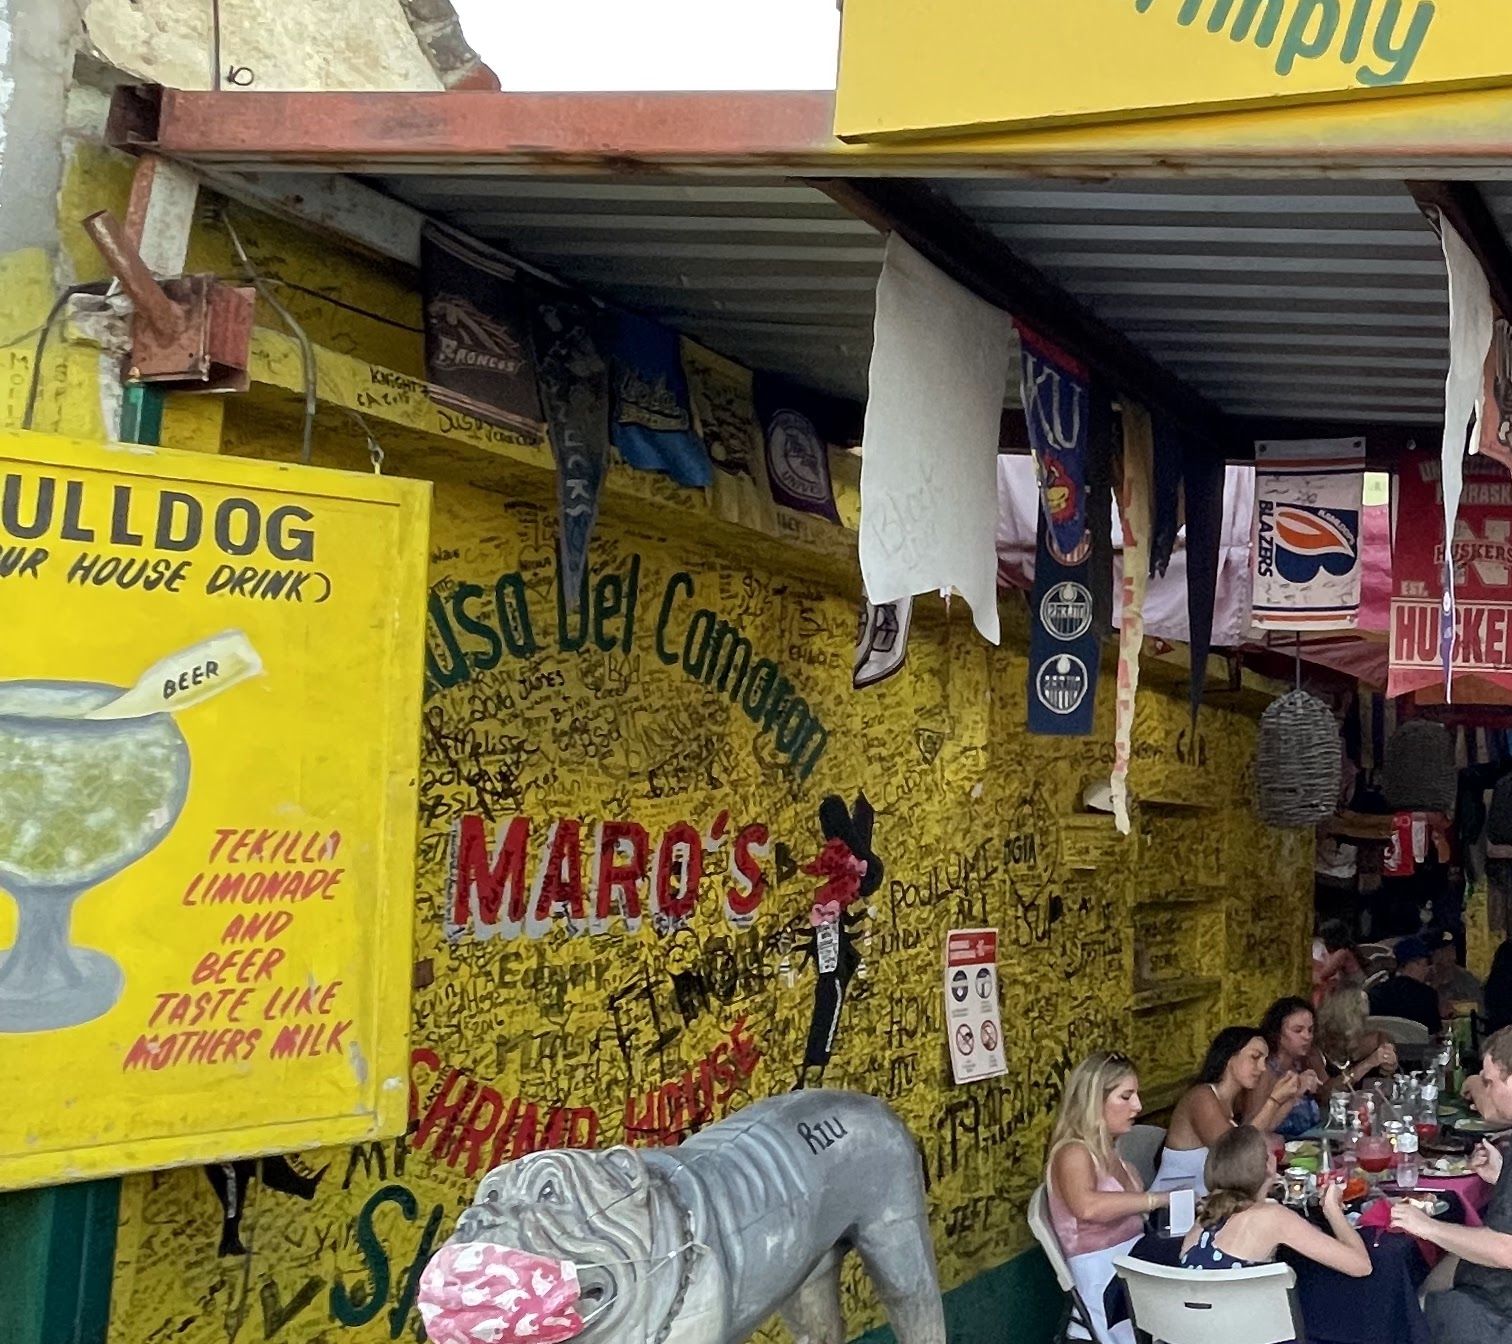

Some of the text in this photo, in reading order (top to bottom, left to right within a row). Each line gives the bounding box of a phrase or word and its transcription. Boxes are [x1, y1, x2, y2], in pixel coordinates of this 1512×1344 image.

[1, 473, 315, 562] ULLDOG
[1258, 499, 1274, 578] BLAZERS
[0, 544, 49, 579] UR
[67, 552, 192, 593] HOUSE
[424, 572, 536, 690] asa
[163, 660, 219, 699] BEER
[209, 829, 342, 864] TEKILLA
[182, 869, 345, 906] LIMONADE
[443, 809, 771, 941] MARO'S
[221, 910, 294, 945] AND
[191, 948, 286, 985] BEER
[148, 981, 343, 1028] TASTE LIKE
[123, 1019, 353, 1072] MOTHERS MILK
[625, 1014, 761, 1147] HOUSE
[797, 1116, 848, 1155] RIU
